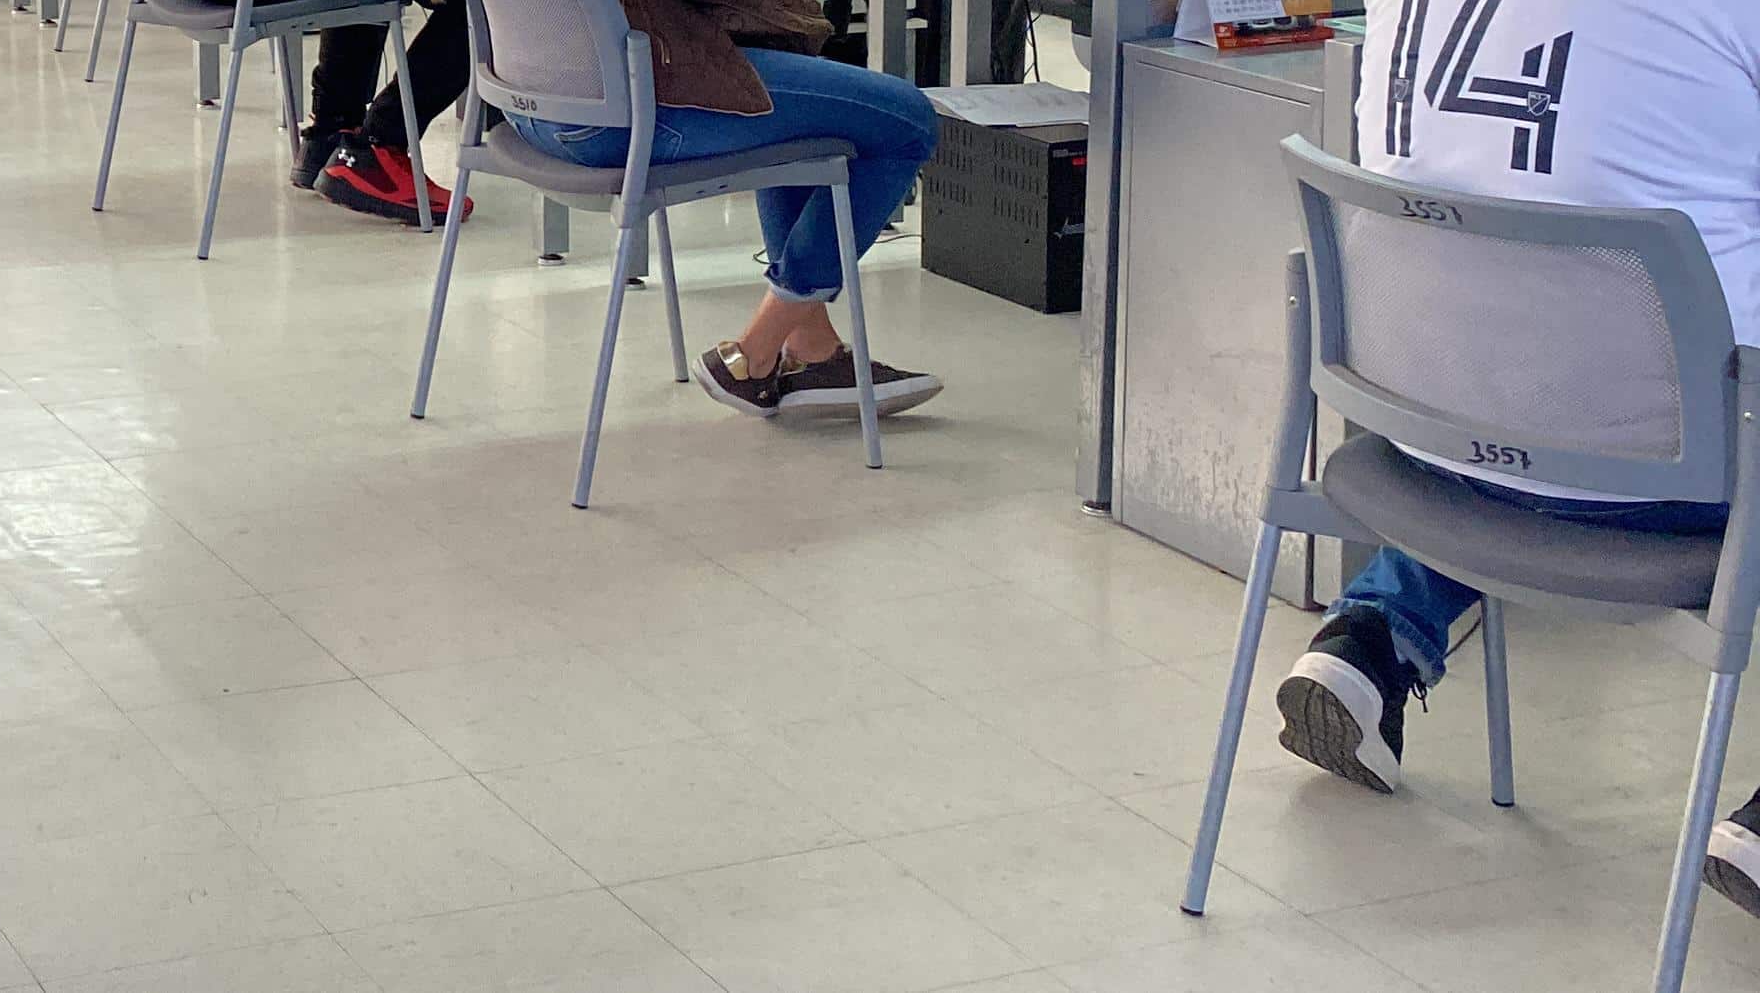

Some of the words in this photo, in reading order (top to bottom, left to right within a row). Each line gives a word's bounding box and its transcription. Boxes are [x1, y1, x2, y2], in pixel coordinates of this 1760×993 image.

[511, 95, 538, 112] 3510
[1398, 195, 1463, 226] 3557
[1466, 440, 1532, 470] 3557
